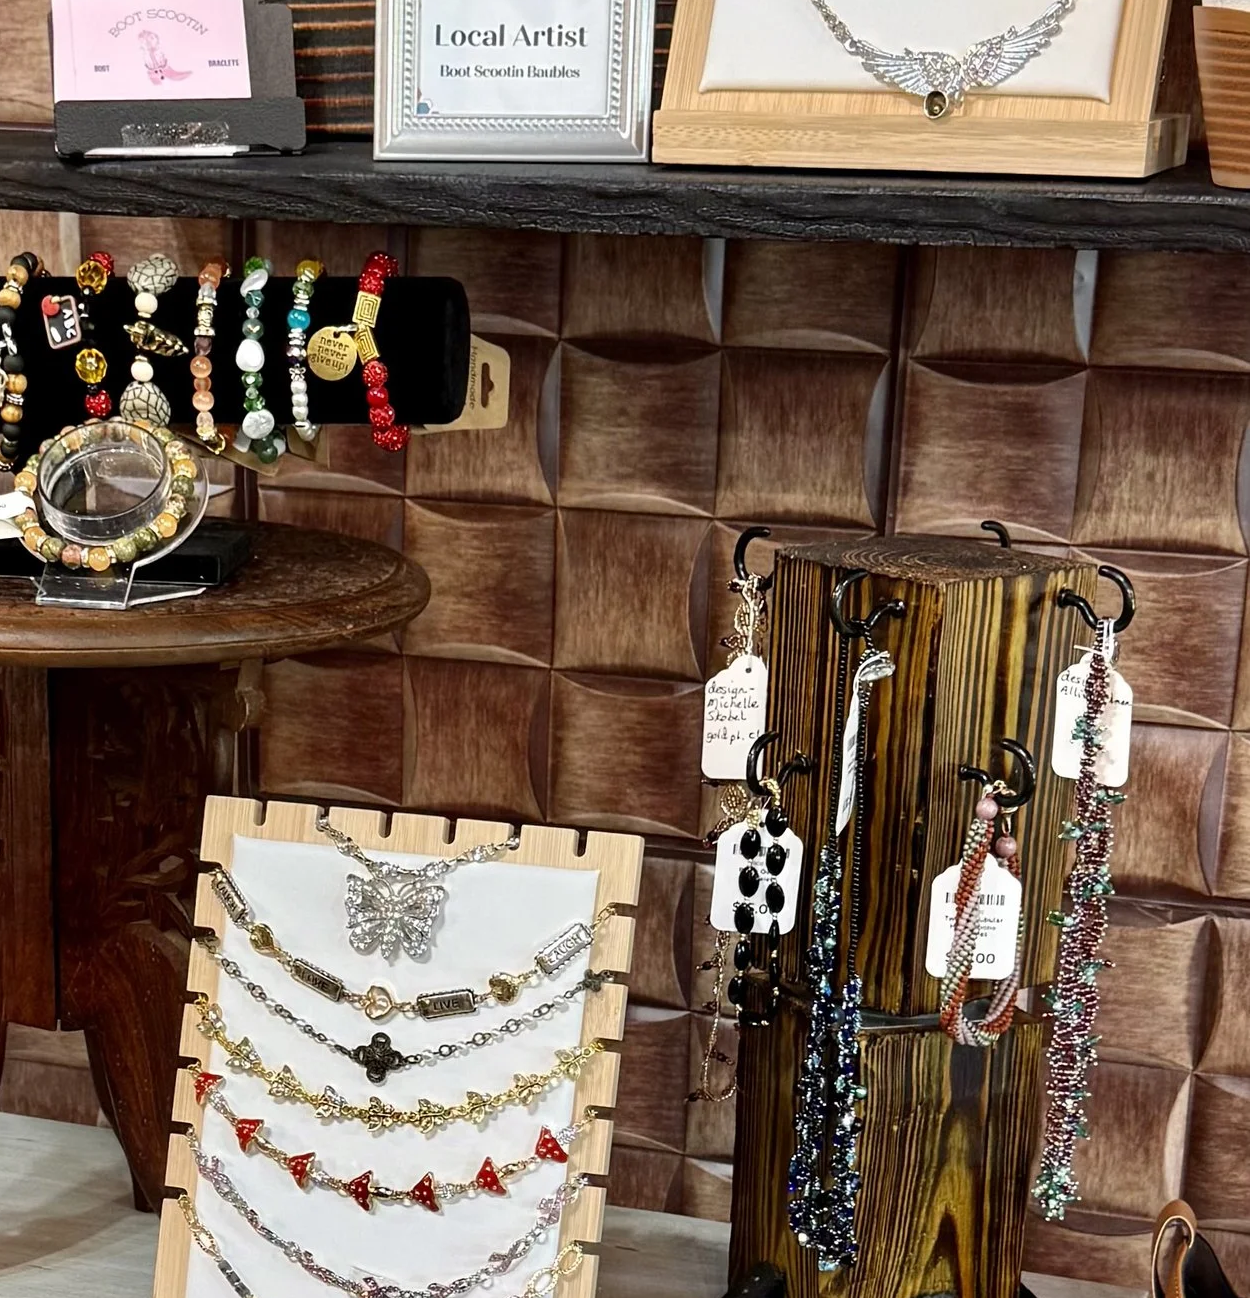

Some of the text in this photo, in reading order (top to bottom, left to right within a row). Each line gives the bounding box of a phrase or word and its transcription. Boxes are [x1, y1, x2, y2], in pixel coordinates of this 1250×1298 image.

[108, 8, 208, 38] BOOT SCOOTIN
[435, 24, 588, 48] Local Artist
[94, 64, 110, 73] BOOT
[440, 64, 580, 79] Boot Scootin Baubles
[62, 308, 77, 339] ABC
[317, 345, 348, 361] never
[320, 336, 350, 352] never
[469, 345, 478, 410] Handmade
[707, 695, 759, 710] Michelle
[706, 726, 728, 744] gold
[549, 931, 584, 965] LAUGH
[301, 968, 331, 992] LOVE
[432, 998, 461, 1012] LIVE
